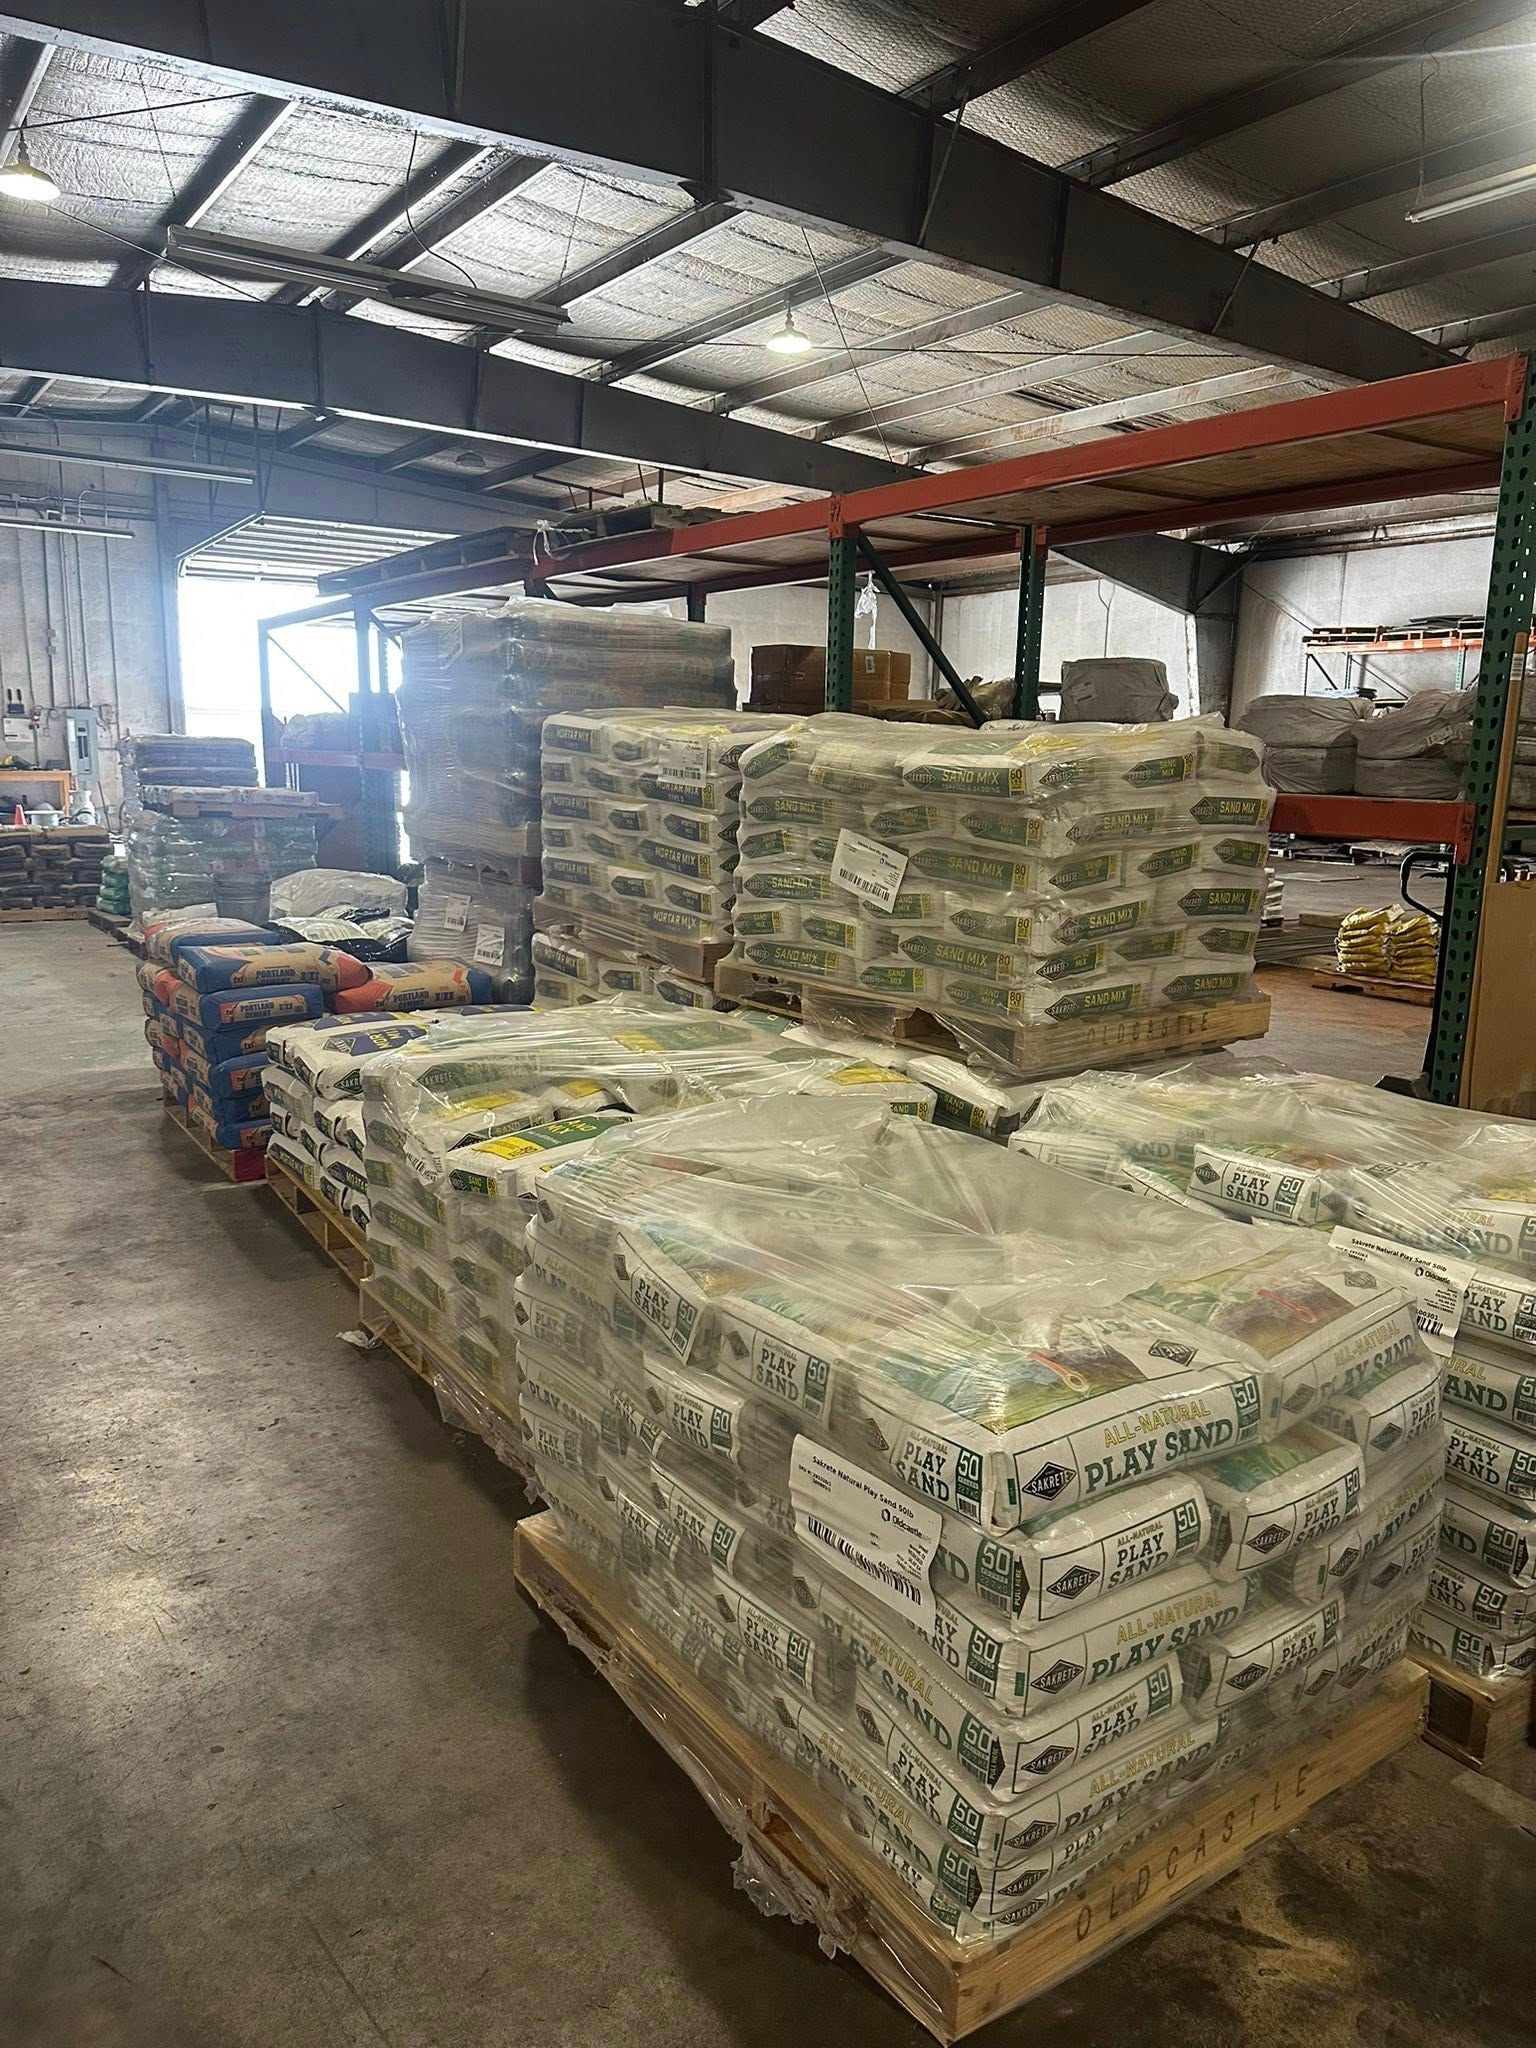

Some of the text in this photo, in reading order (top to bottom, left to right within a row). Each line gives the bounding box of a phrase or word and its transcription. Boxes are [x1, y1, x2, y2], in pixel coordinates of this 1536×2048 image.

[942, 769, 1000, 785] SAND MIX
[1103, 813, 1150, 830] SAND MIX
[1219, 801, 1256, 814] SAND MIX
[1028, 820, 1040, 830] 80
[656, 847, 696, 865] MORTAR MIX
[949, 856, 1005, 877] SAND MIX
[1014, 864, 1026, 874] 80
[1209, 892, 1247, 905] SAND MIX
[654, 911, 697, 929] MORTAR MIX
[1017, 918, 1030, 929] 80
[1089, 909, 1134, 929] SAND MIX
[774, 948, 817, 964] SAND MIX
[935, 945, 989, 967] SAND MIX
[256, 968, 297, 980] PORTLAND
[1194, 976, 1233, 990] SAND MIX
[240, 1001, 275, 1013] PORTLAND
[1010, 991, 1022, 1001] 80
[1084, 990, 1128, 1008] SAND MIX
[245, 1009, 271, 1019] CEMENT
[919, 1103, 928, 1113] 80
[944, 1094, 965, 1110] SAND
[973, 1107, 983, 1119] 80
[1226, 1184, 1270, 1207] SAND
[1232, 1172, 1270, 1192] PLAY
[1280, 1177, 1302, 1193] 50
[1351, 1238, 1375, 1250] Sakrete
[1375, 1244, 1400, 1258] Natural
[1400, 1252, 1413, 1263] Play
[1414, 1257, 1432, 1267] Sand
[638, 1278, 670, 1312] PLAY
[634, 1290, 672, 1331] SAND
[679, 1299, 696, 1326] 50
[761, 1347, 797, 1379] PLAY
[1374, 1334, 1414, 1370] SAND
[756, 1364, 799, 1402] SAND
[808, 1358, 828, 1385] 50
[1233, 1378, 1257, 1408] 50
[673, 1402, 704, 1430] PLAY
[713, 1409, 730, 1432] 50
[1104, 1399, 1212, 1448] ALL-NATURAL
[671, 1418, 709, 1450] SAND
[911, 1430, 948, 1455] ALL-NATURAL
[903, 1440, 947, 1477] PLAY
[958, 1449, 980, 1481] 50
[1084, 1418, 1233, 1494] PLAY SAND
[1448, 1435, 1499, 1467] PLAY
[812, 1455, 837, 1475] Sakrete
[837, 1470, 863, 1490] Natural
[864, 1484, 879, 1500] Play
[879, 1493, 898, 1510] Sand
[898, 1504, 914, 1519] 50lb
[895, 1462, 950, 1502] SAND
[1031, 1468, 1074, 1494] SAKRETE
[1346, 1472, 1360, 1497] 50
[677, 1504, 706, 1535] PLAY
[892, 1515, 924, 1540] Oldcastle
[1177, 1501, 1197, 1532] 50
[1304, 1498, 1340, 1529] PLAY
[713, 1524, 735, 1550] 50
[1117, 1520, 1164, 1548] ALL-NATURAL
[1294, 1515, 1341, 1548] SAND
[1490, 1523, 1517, 1550] 50
[982, 1541, 1011, 1576] 50
[1117, 1531, 1165, 1569] PLAY
[1055, 1571, 1096, 1593] SAKRETE
[1108, 1551, 1169, 1590] SAND
[1479, 1586, 1503, 1609] 50
[1117, 1590, 1224, 1646] ALL-NATURAL
[1324, 1606, 1338, 1630] 50
[745, 1616, 780, 1651] PLAY
[789, 1633, 810, 1662] 50
[972, 1629, 998, 1664] 50
[1086, 1606, 1239, 1686] PLAY SAND
[1281, 1631, 1317, 1664] PLAY
[1458, 1632, 1482, 1654] 50
[841, 1607, 934, 1707] ALL-NATURAL
[1039, 1664, 1080, 1689] SAKRETE
[1150, 1671, 1170, 1699] 50
[881, 1668, 953, 1751] SAND
[1091, 1692, 1138, 1724] ALL-NATURAL
[1091, 1702, 1138, 1741] PLAY
[964, 1718, 993, 1752] 50
[1080, 1717, 1141, 1761] SAND
[900, 1742, 943, 1791] ALL-NATURAL
[1030, 1748, 1071, 1771] SAKRETE
[1089, 1731, 1196, 1798] ALL-NATURAL
[819, 1731, 913, 1834] ALL-NATURAL
[897, 1750, 940, 1804] PLAY
[1062, 1782, 1137, 1835] PLAY
[1142, 1742, 1212, 1786] SAND
[891, 1763, 942, 1826] SAND
[954, 1797, 980, 1830] 50
[863, 1794, 933, 1874] SAND
[1014, 1824, 1051, 1847] SAKRETE
[1064, 1822, 1106, 1862] PLAY
[882, 1840, 923, 1889] PLAY
[944, 1847, 970, 1880] 50
[1076, 1765, 1312, 1942] OLDCASTLE
[1006, 1870, 1044, 1894] SAKRETE
[1004, 1901, 1042, 1923] SAKRETE
